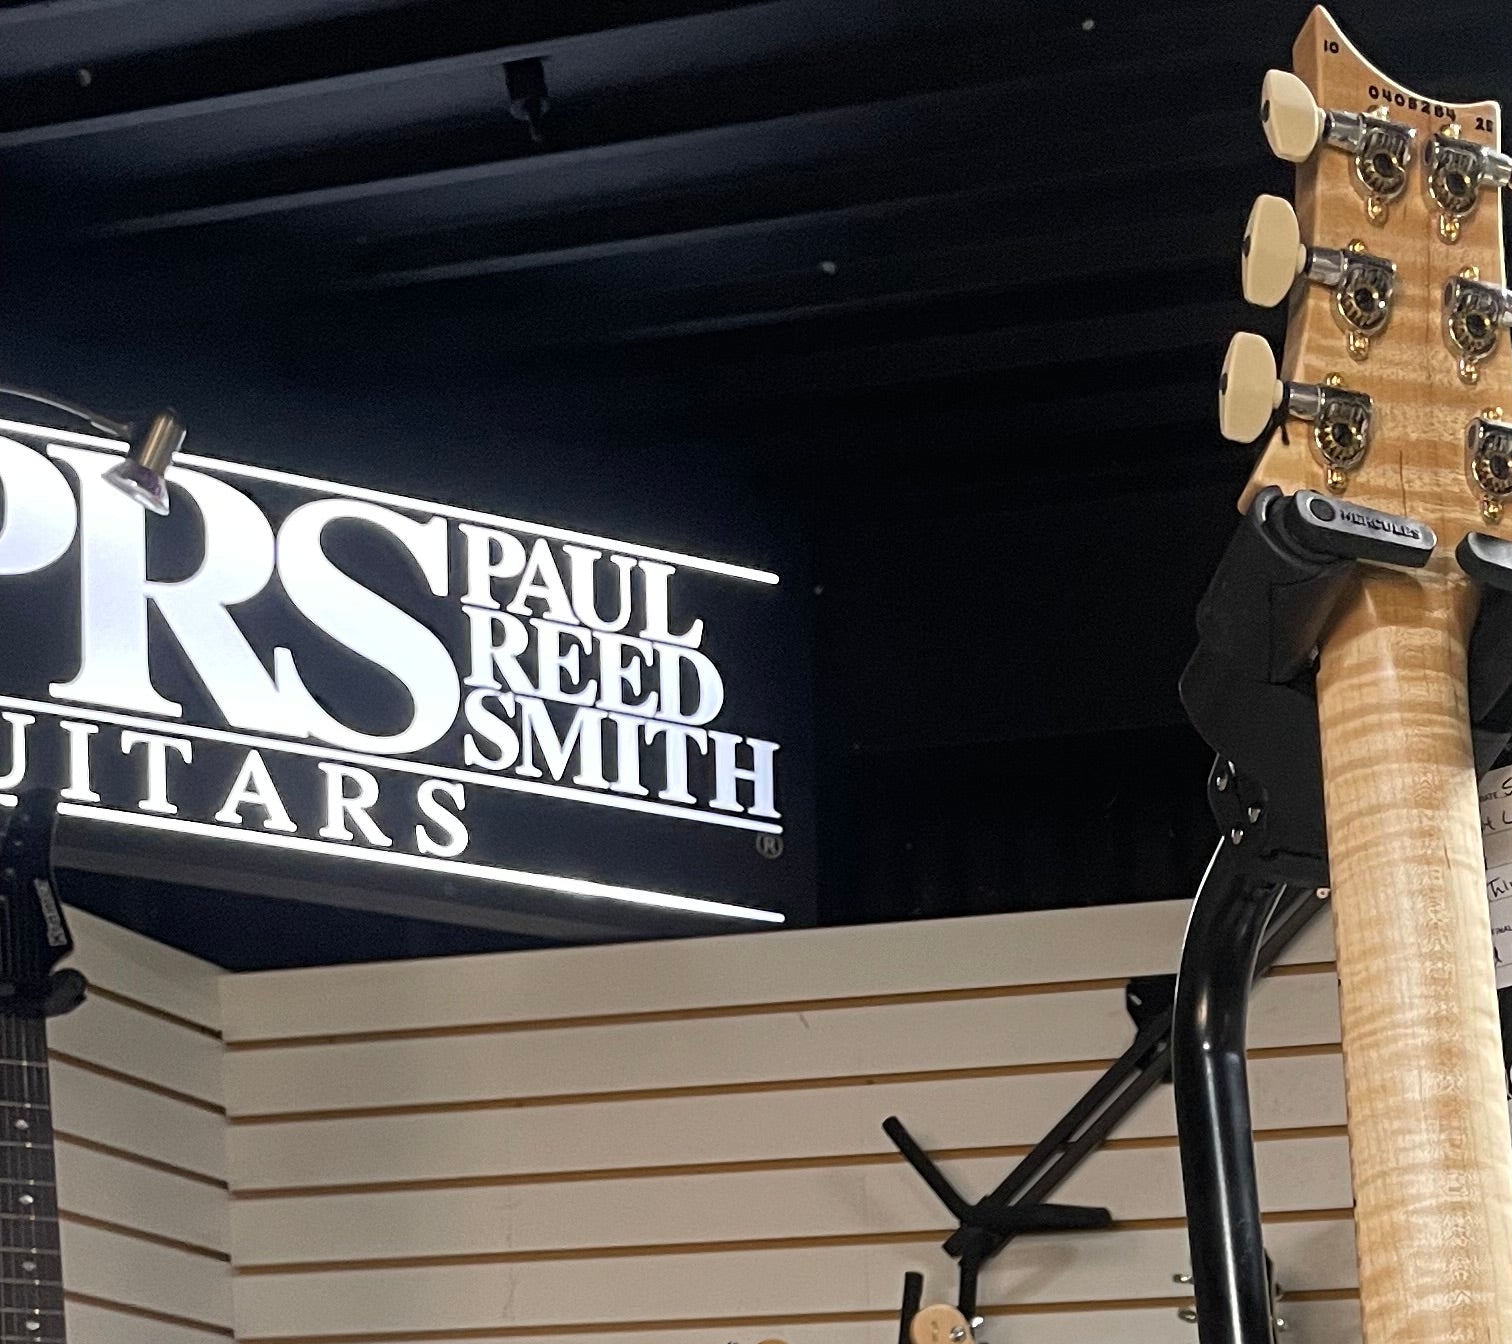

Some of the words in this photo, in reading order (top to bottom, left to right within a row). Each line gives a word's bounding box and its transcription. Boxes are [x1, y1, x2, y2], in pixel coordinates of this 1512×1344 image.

[1323, 39, 1340, 54] 10
[459, 520, 704, 649] PAUL
[461, 604, 726, 728] REED
[462, 689, 782, 820] SMITH
